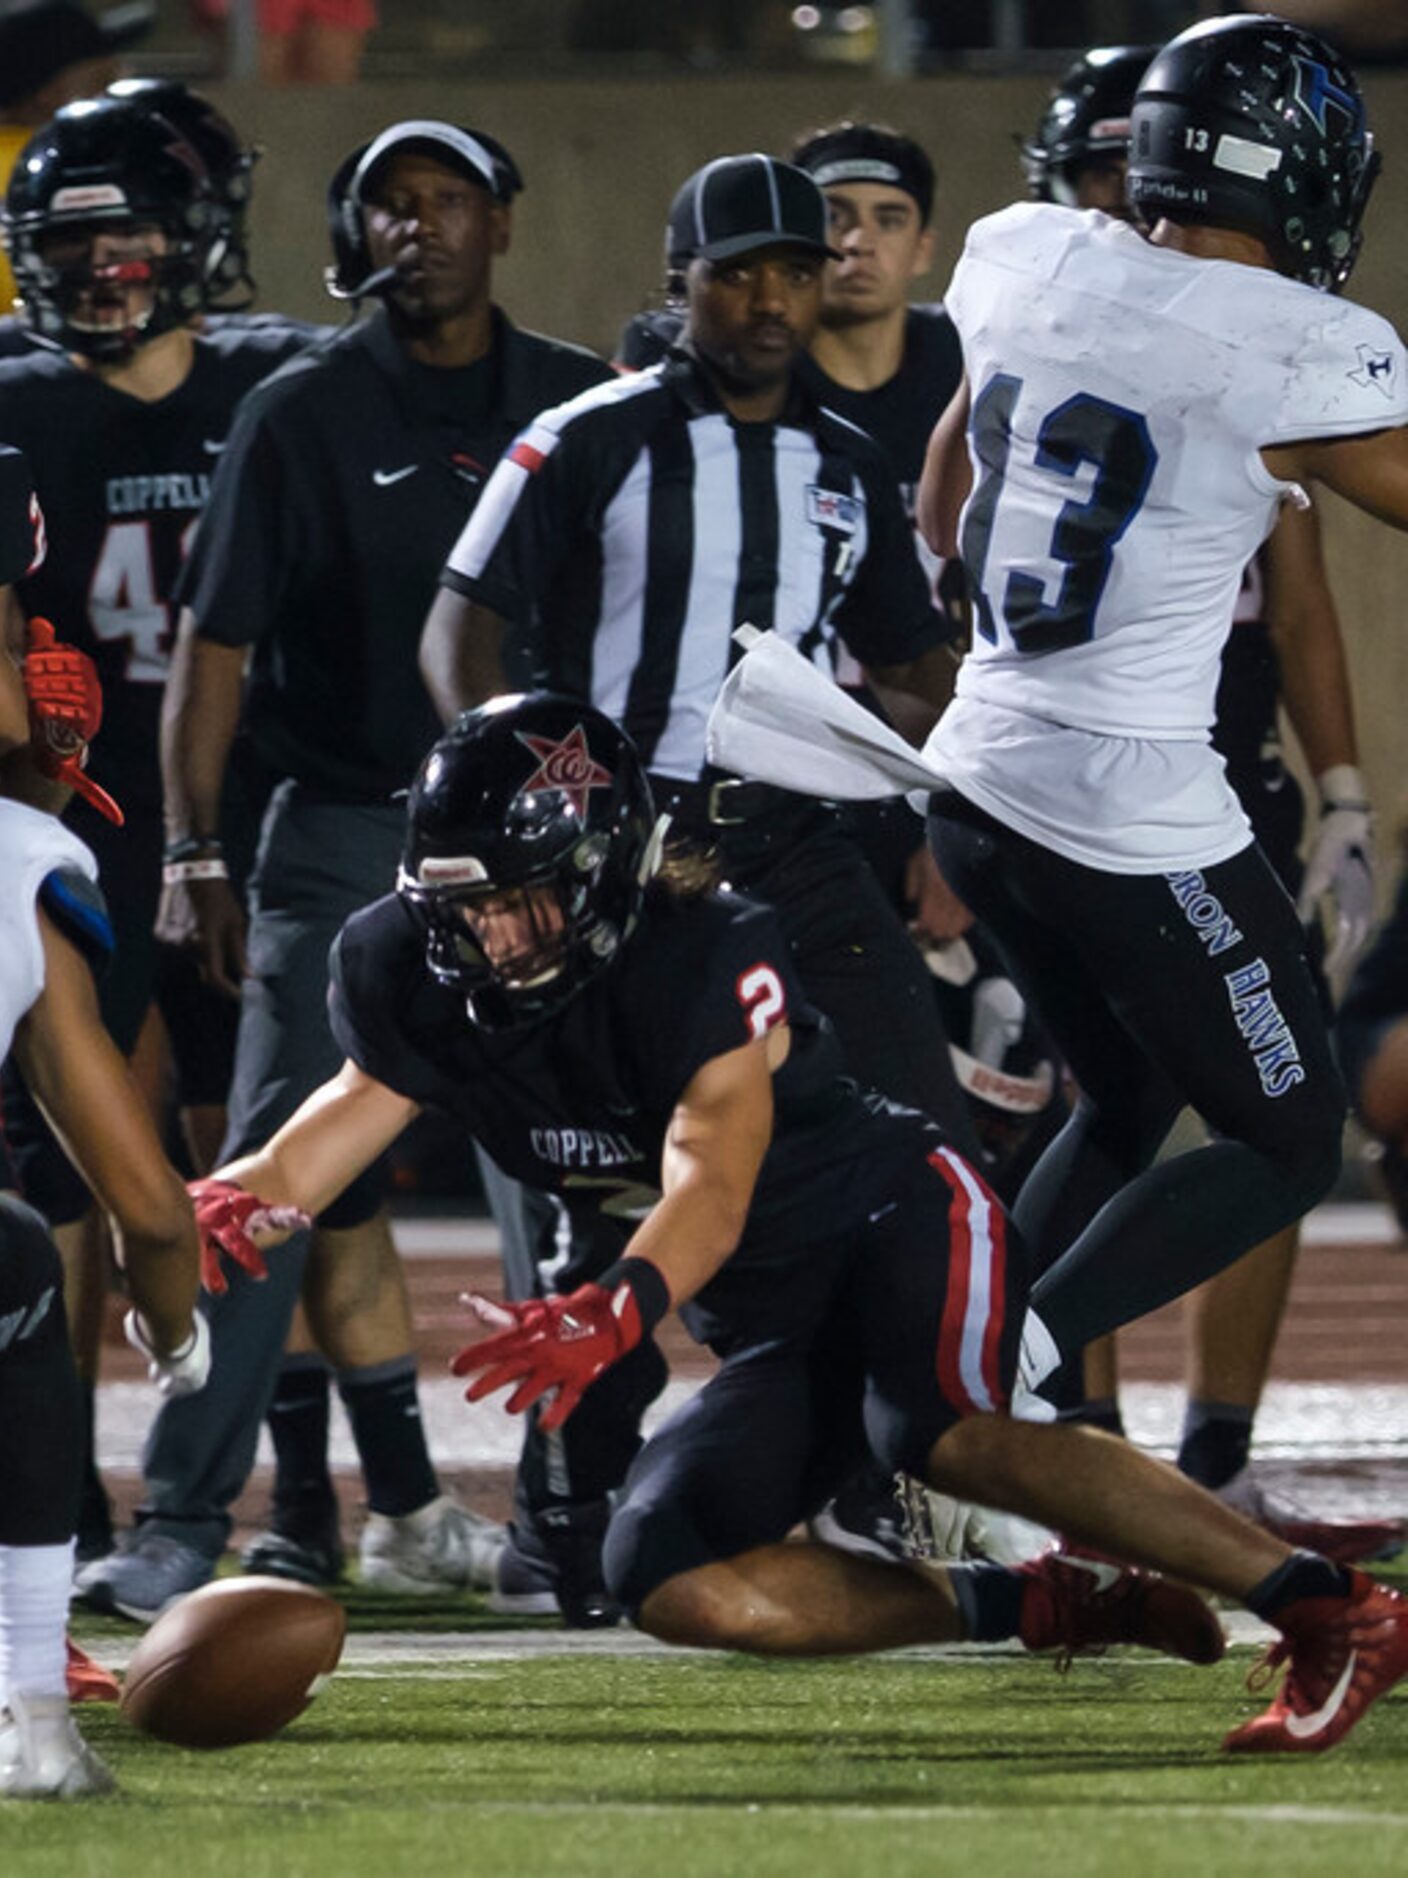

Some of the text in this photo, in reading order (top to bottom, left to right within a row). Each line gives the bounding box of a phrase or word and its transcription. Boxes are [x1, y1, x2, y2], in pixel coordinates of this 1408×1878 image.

[1184, 127, 1208, 152] 13
[962, 371, 1159, 653] 13
[1224, 957, 1306, 1097] HAWKS
